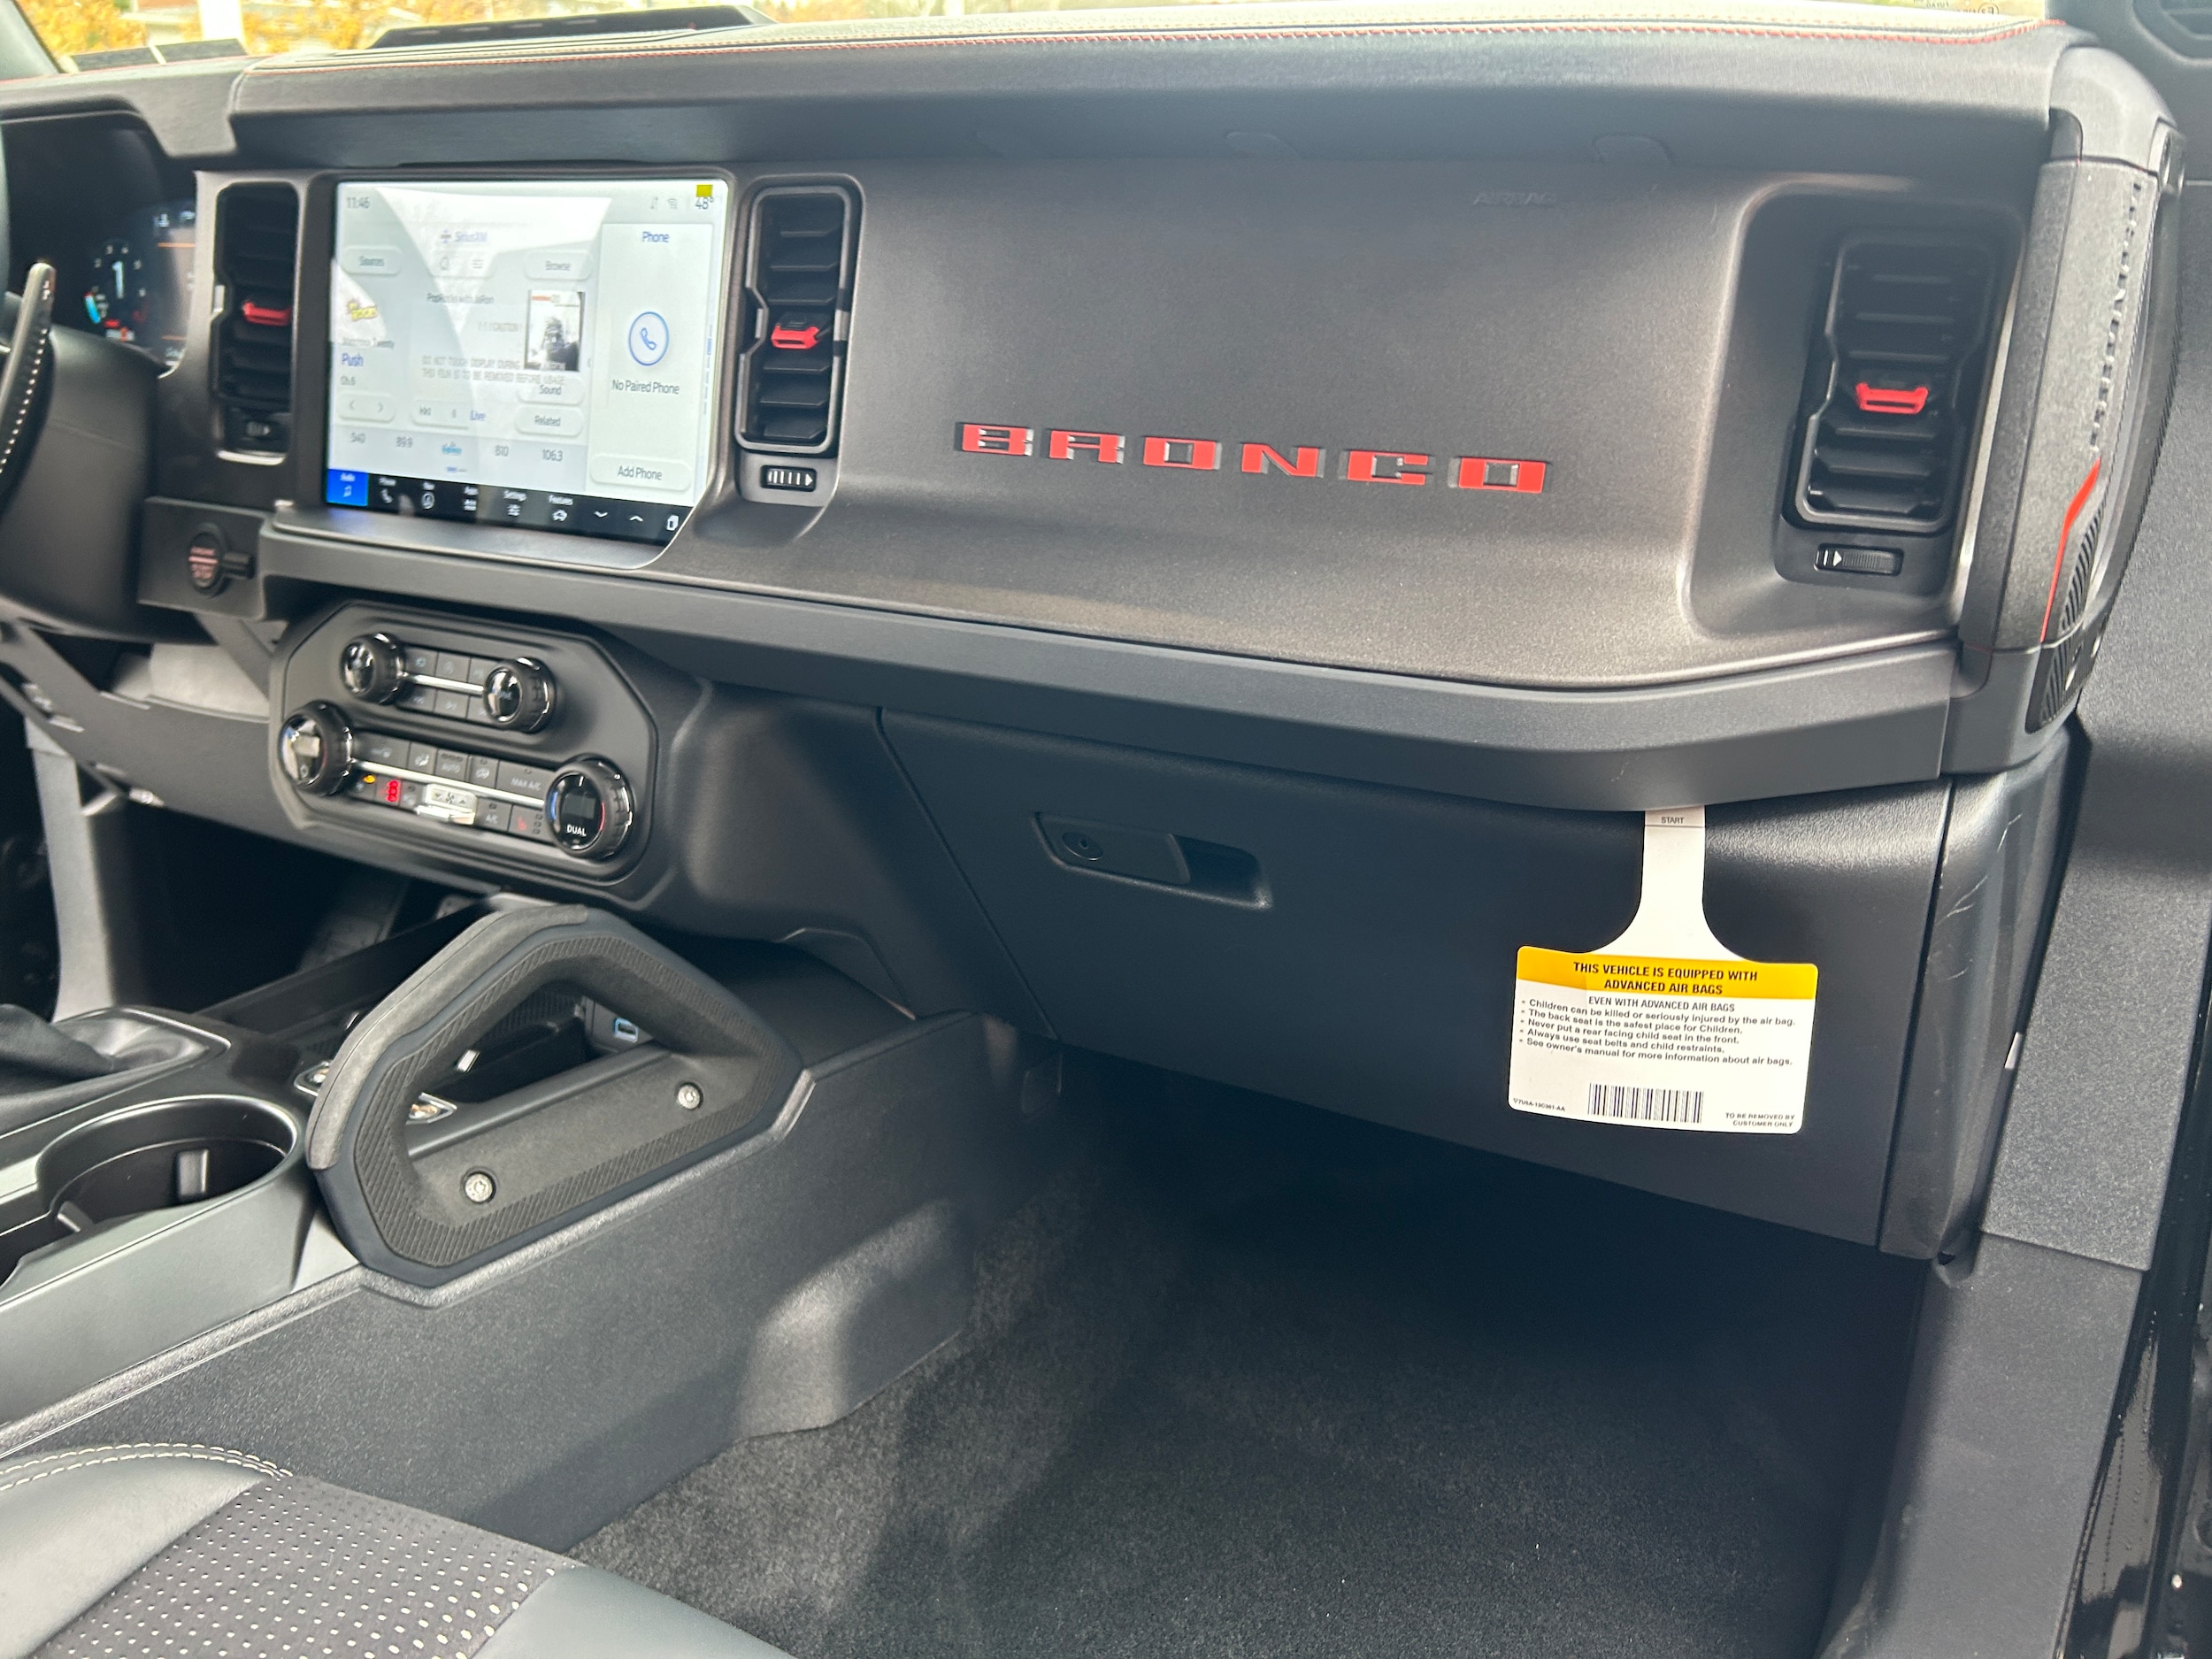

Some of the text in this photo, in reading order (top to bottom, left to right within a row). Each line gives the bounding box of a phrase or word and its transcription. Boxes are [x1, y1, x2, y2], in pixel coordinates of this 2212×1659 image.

[641, 231, 670, 243] Phone
[545, 260, 572, 272] Browse
[342, 352, 365, 367] Push
[539, 385, 562, 396] Sound
[611, 380, 680, 395] No Paired Phone
[534, 415, 561, 426] Related
[541, 449, 564, 462] 106.3
[959, 421, 1548, 494] BRONCO
[618, 465, 663, 480] Add Phone
[511, 777, 527, 787] MAX
[1661, 816, 1685, 825] START
[566, 824, 587, 837] DUAL
[1573, 961, 1758, 981] THIS VEHICLE IS EQUIPPED WITH
[1604, 979, 1723, 995] ADVANCED AIR BAGS
[1588, 996, 1735, 1012] EVEN WITH ADVANCED AIR BAGS
[1529, 999, 1568, 1012] Children
[1571, 1006, 1587, 1015] can
[1604, 1009, 1630, 1018] killed
[1646, 1013, 1689, 1023] seriously
[1693, 1014, 1725, 1024] injured
[1728, 1015, 1740, 1025] by
[1760, 1017, 1773, 1025] air
[1775, 1018, 1795, 1027] bag.
[1529, 1009, 1546, 1018] The
[1548, 1013, 1571, 1022] back
[1624, 1021, 1652, 1030] safest
[1655, 1023, 1681, 1033] place
[1700, 1025, 1743, 1034] Children.
[1528, 1018, 1555, 1030] Never
[1557, 1024, 1572, 1033] put
[1604, 1029, 1633, 1041] facing
[1636, 1031, 1659, 1041] child
[1527, 1028, 1561, 1041] Always
[1583, 1037, 1602, 1046] seat
[1605, 1039, 1628, 1048] belts
[1630, 1041, 1648, 1049] and
[1651, 1041, 1674, 1050] child
[1527, 1038, 1544, 1048] See
[1547, 1043, 1582, 1054] owner's
[1585, 1048, 1620, 1057] manual
[1623, 1049, 1636, 1058] for
[1665, 1053, 1720, 1064] information
[1723, 1056, 1750, 1064] about
[1767, 1058, 1793, 1067] bags.
